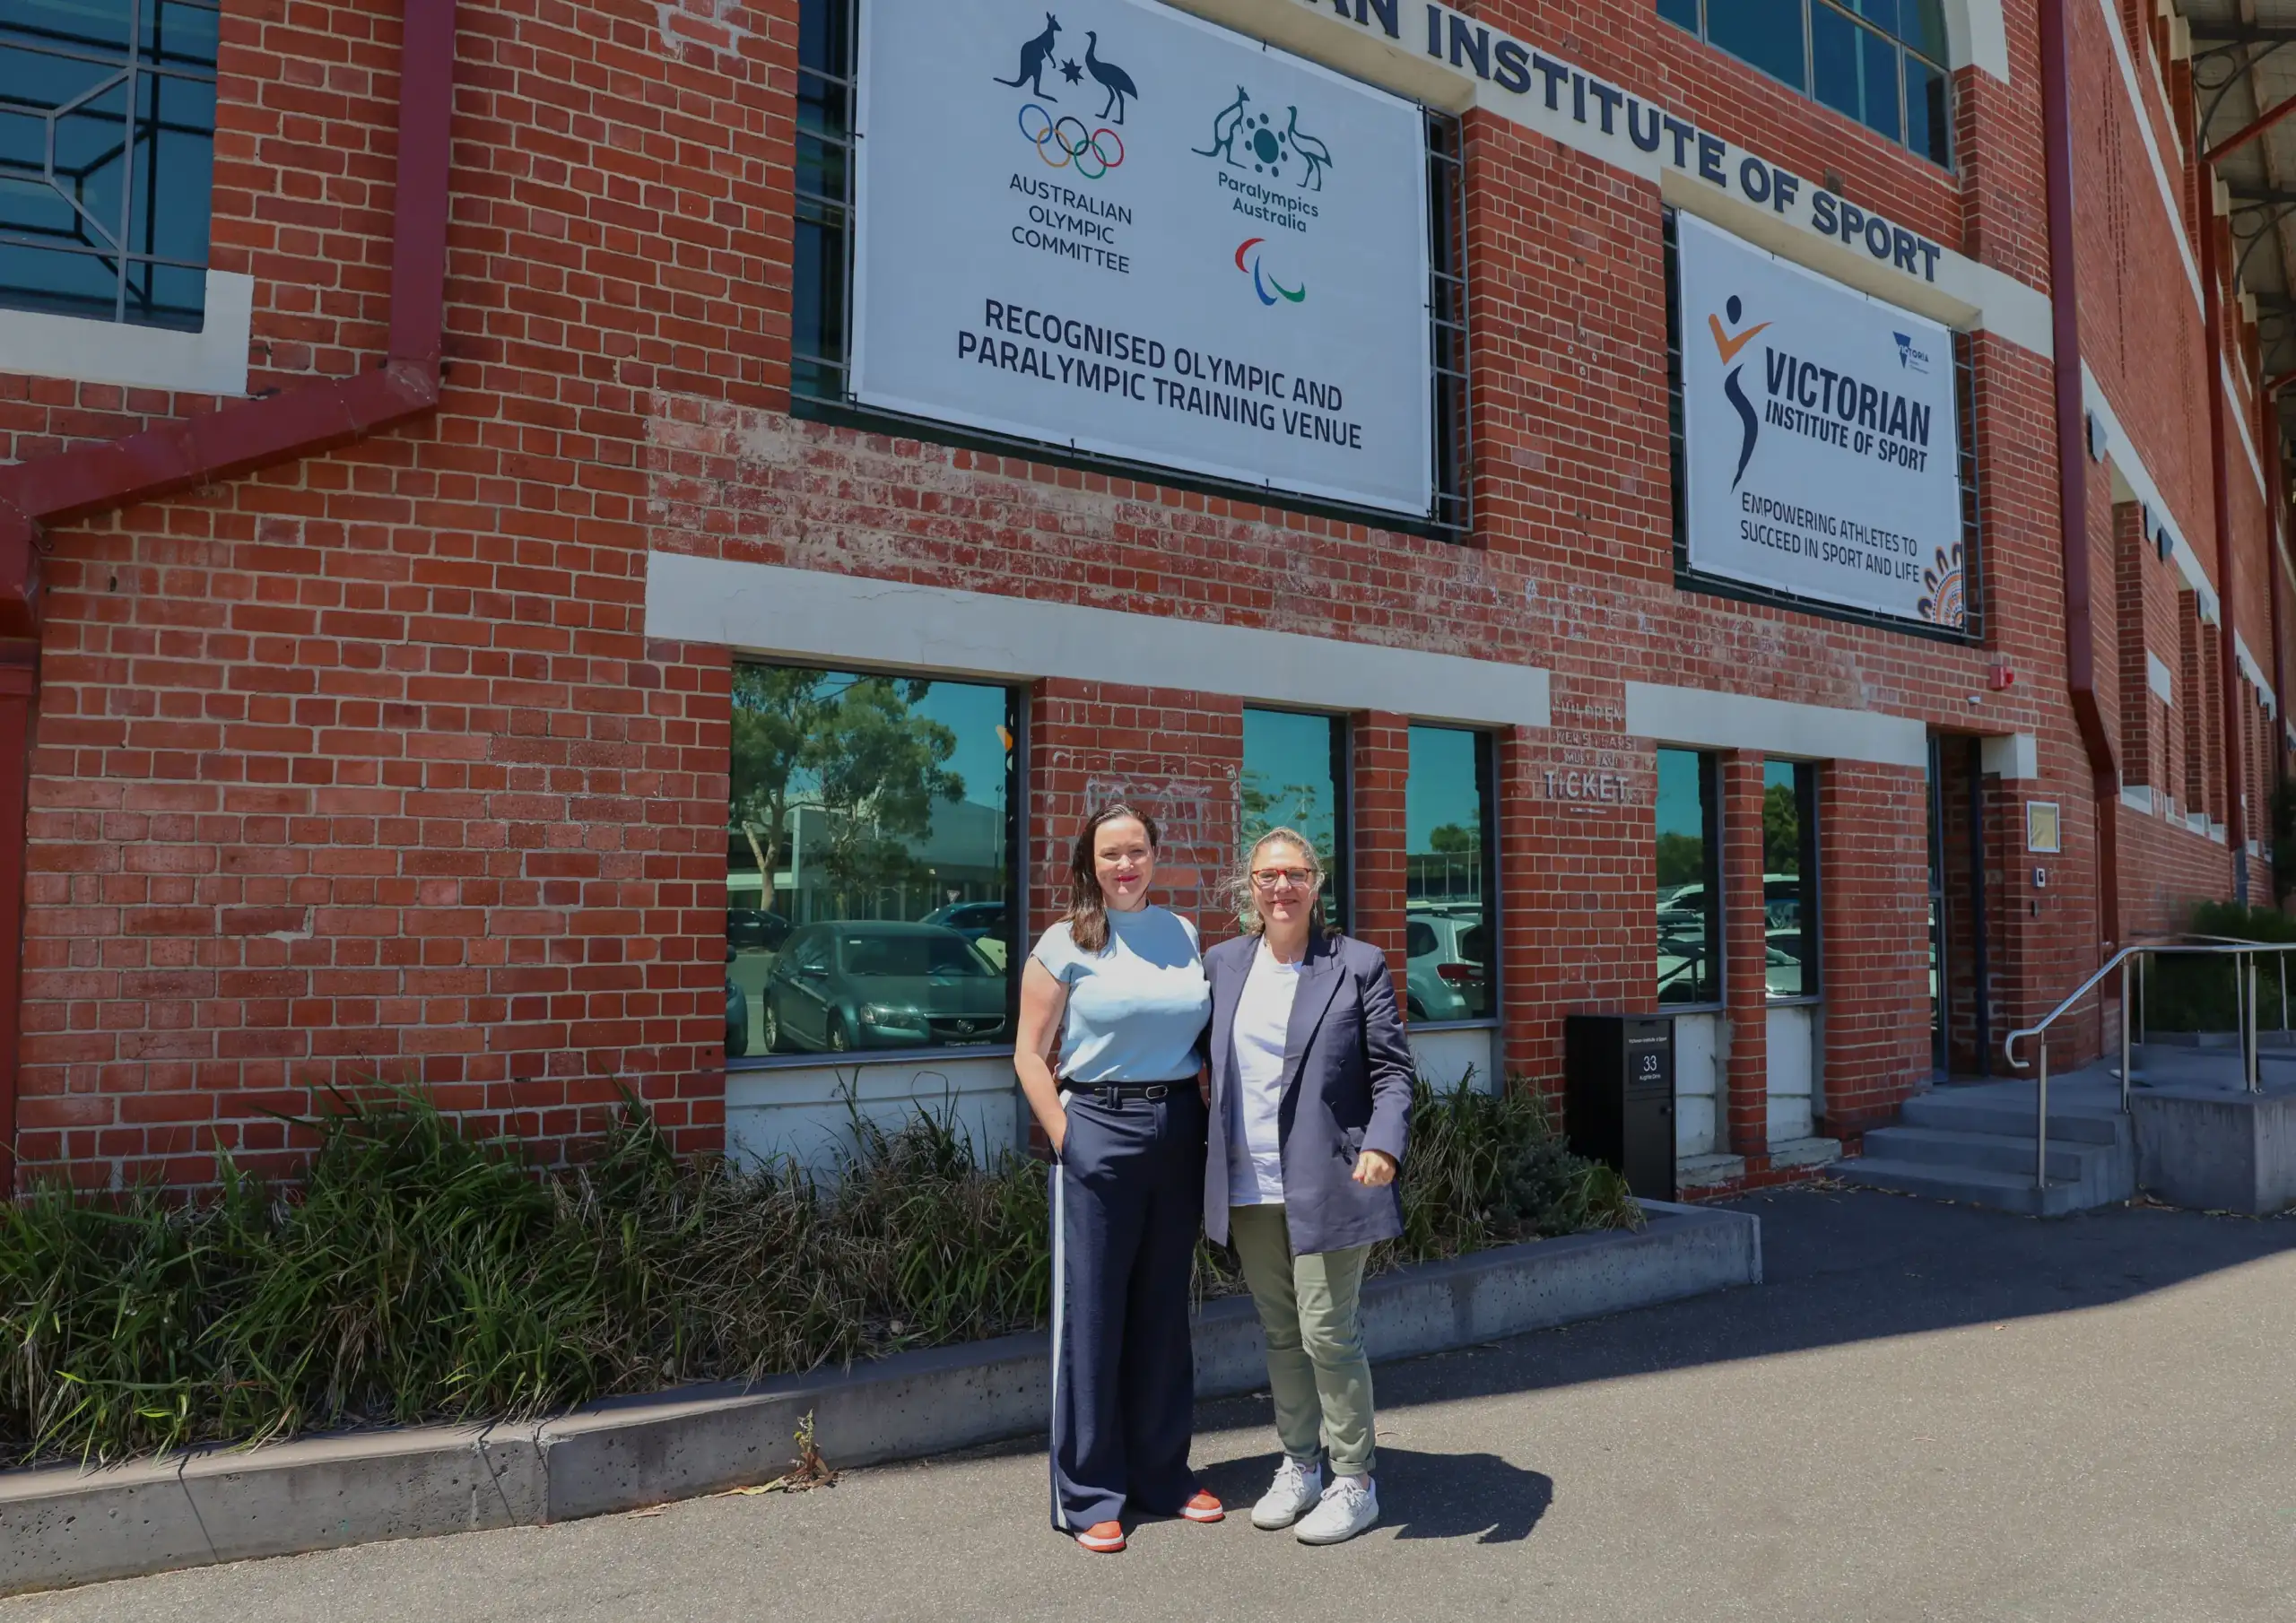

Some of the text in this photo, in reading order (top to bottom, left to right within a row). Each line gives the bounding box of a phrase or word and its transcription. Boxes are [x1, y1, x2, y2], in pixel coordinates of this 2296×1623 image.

[1426, 4, 1726, 187] INSTITUTE
[1740, 158, 1799, 213] OF
[1812, 190, 1941, 282] SPORT
[1009, 173, 1132, 226] AUSTRALIAN
[1217, 170, 1319, 219] Paralympics
[1231, 196, 1307, 233] Australia
[1011, 225, 1130, 274] COMMITTEE
[1028, 204, 1115, 245] OLYMPIC
[985, 298, 1343, 412] RECOGNISED OLYMPIC AND
[958, 330, 1362, 450] PARALYMPIC TRAINING VENUE
[1765, 346, 1931, 447] VICTORIAN
[1765, 399, 1928, 473] INSTITUTE OF SPORT
[1740, 519, 1920, 584] SUCCEED IN SPORT AND LIFE
[1742, 490, 1918, 557] EMPOWERING ATHLETES TO
[1544, 770, 1631, 801] TICKET
[1643, 1055, 1657, 1072] 33
